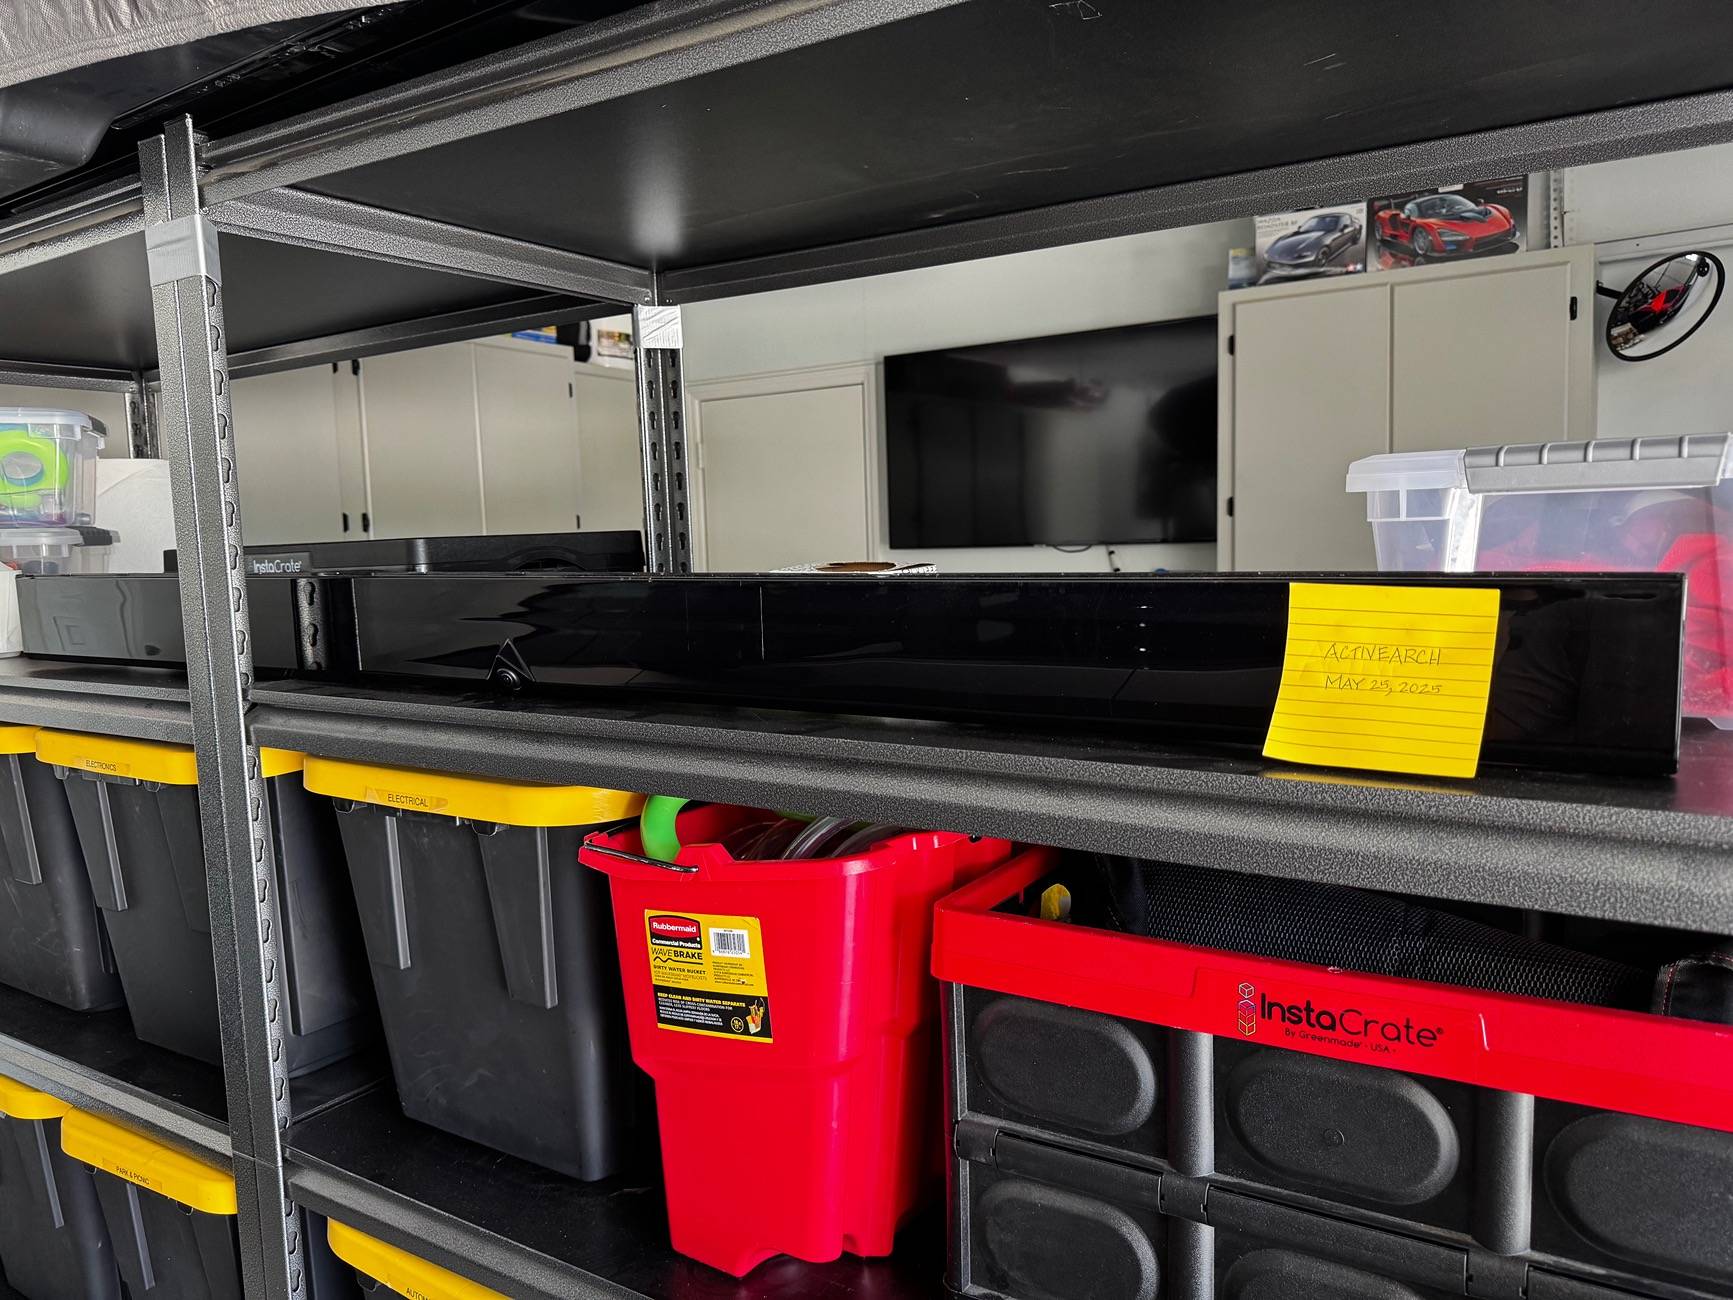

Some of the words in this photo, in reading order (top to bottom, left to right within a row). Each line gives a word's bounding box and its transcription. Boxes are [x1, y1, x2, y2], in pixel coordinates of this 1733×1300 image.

[1323, 642, 1441, 666] ACTIVEARCH
[1324, 673, 1365, 691] MAY
[1370, 679, 1393, 697] 25,
[1398, 681, 1443, 695] 2025
[387, 793, 429, 808] ELECTRICAL
[652, 922, 697, 933] Rubbermaid
[651, 938, 679, 946] Commercial
[679, 941, 701, 949] Products
[1285, 1028, 1296, 1037] By
